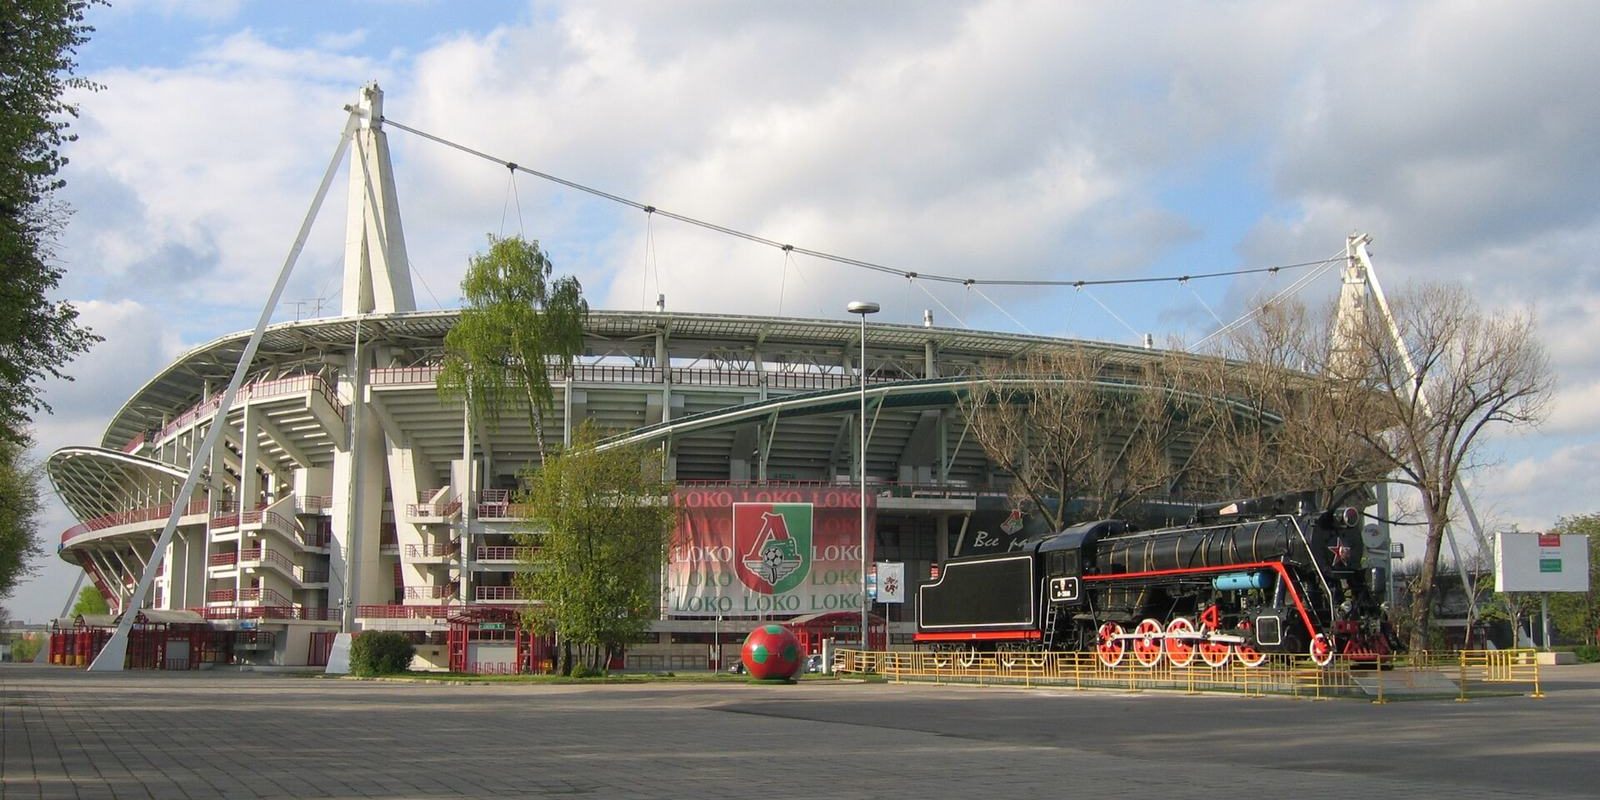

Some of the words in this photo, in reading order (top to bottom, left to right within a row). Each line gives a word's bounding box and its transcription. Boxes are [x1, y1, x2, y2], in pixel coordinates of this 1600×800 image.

[673, 491, 733, 508] LOKO
[812, 491, 871, 508] LOKO
[675, 546, 733, 562] LOKO
[674, 596, 733, 612] LOKO
[744, 595, 800, 611] LOKO
